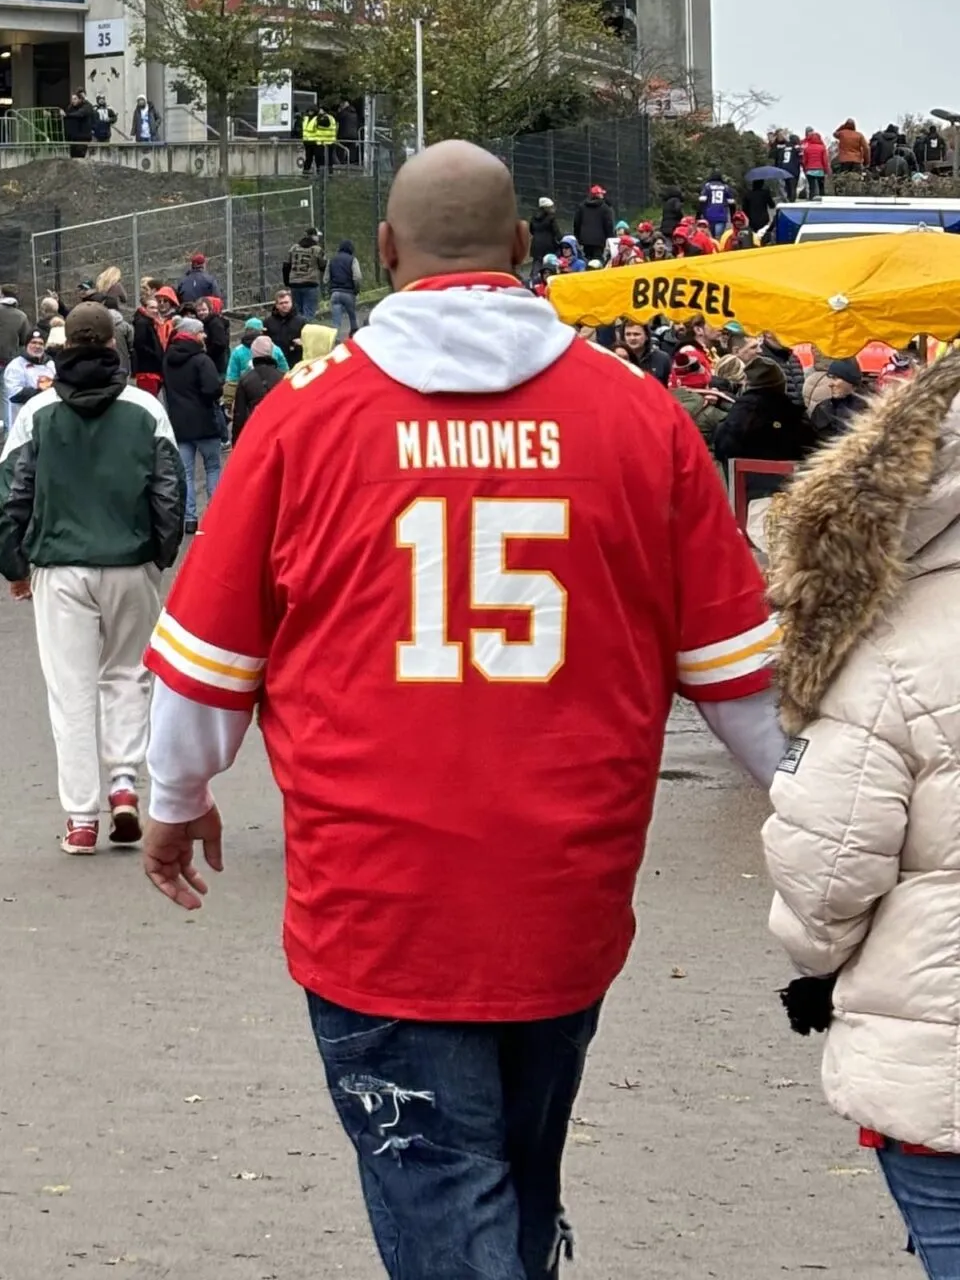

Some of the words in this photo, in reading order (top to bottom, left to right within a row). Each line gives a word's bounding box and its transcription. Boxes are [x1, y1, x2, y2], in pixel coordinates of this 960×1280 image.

[98, 32, 111, 47] 35
[783, 151, 792, 163] 9
[711, 191, 724, 204] 19
[632, 276, 735, 318] BREZEL
[396, 420, 561, 469] MAHOMES
[395, 496, 569, 682] 15
